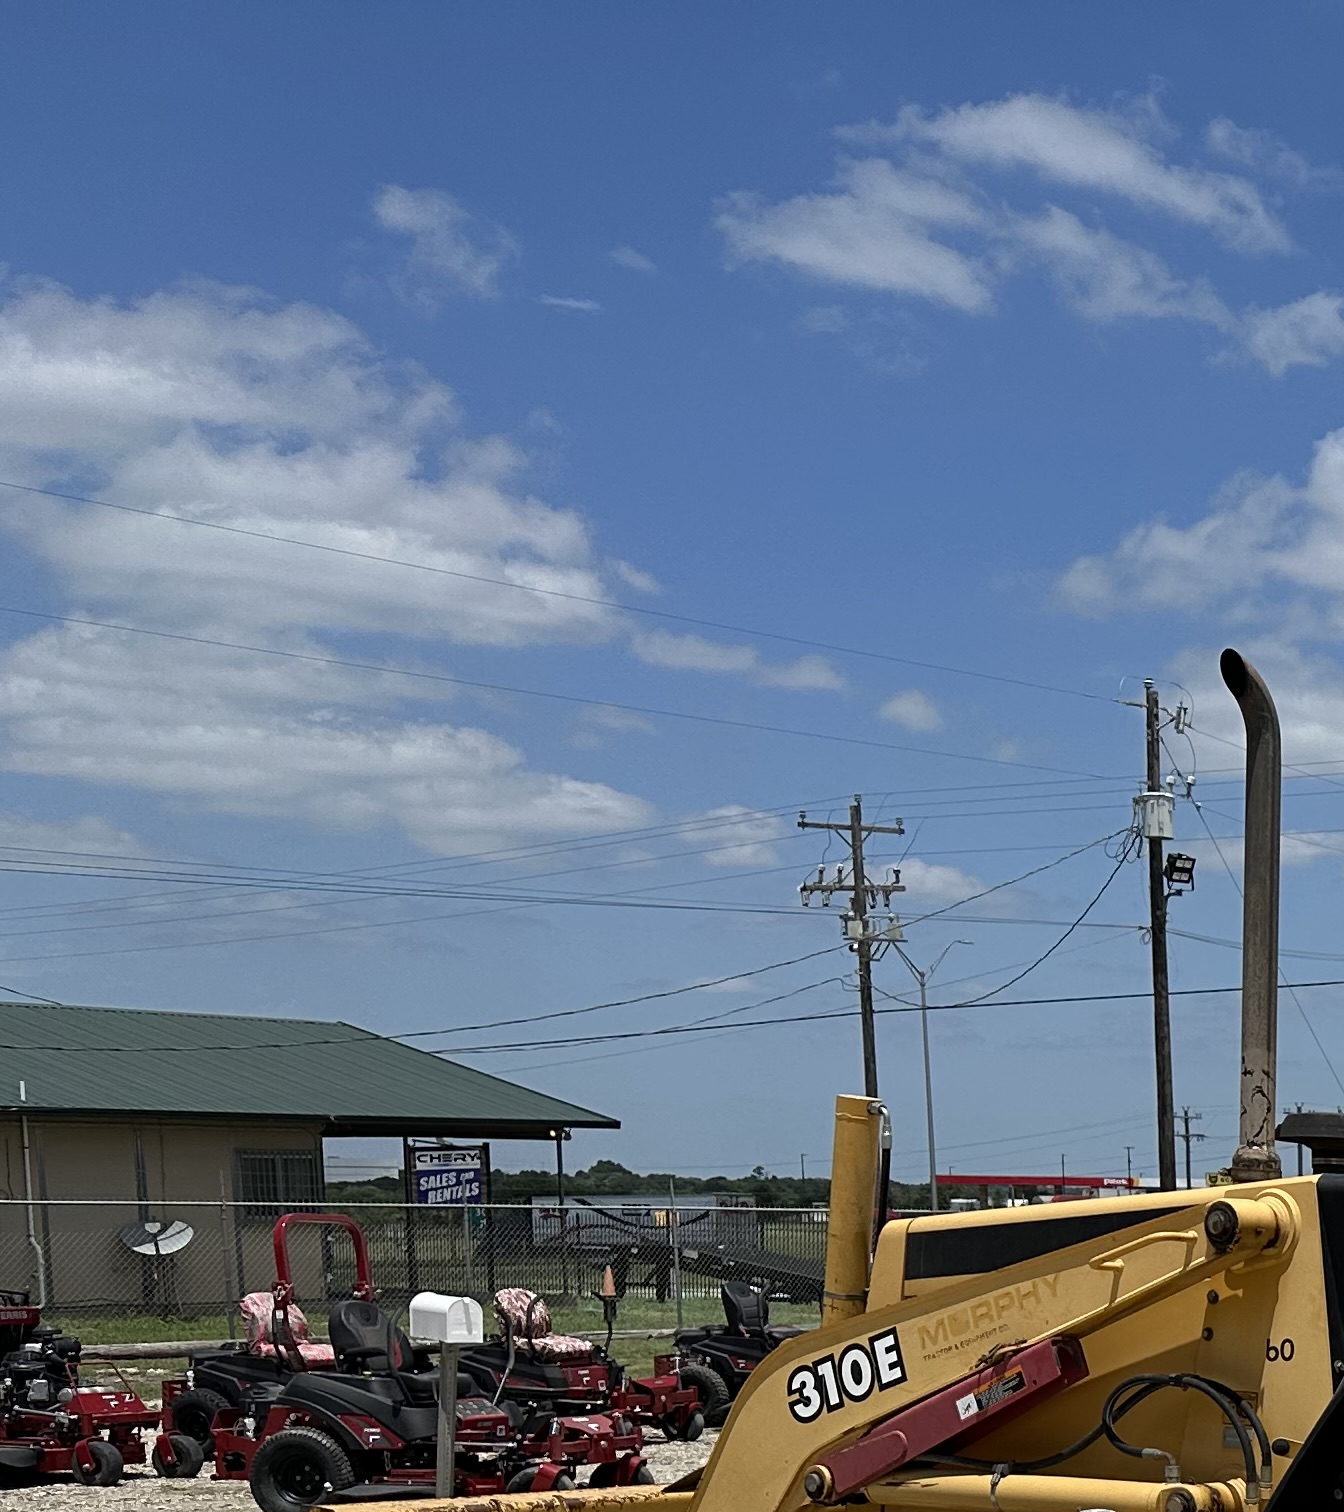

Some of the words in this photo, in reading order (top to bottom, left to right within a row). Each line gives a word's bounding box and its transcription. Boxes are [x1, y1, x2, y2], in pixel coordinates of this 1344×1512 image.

[420, 1171, 457, 1191] SALES
[0, 1311, 28, 1320] ERRIS
[788, 1328, 906, 1422] 310E
